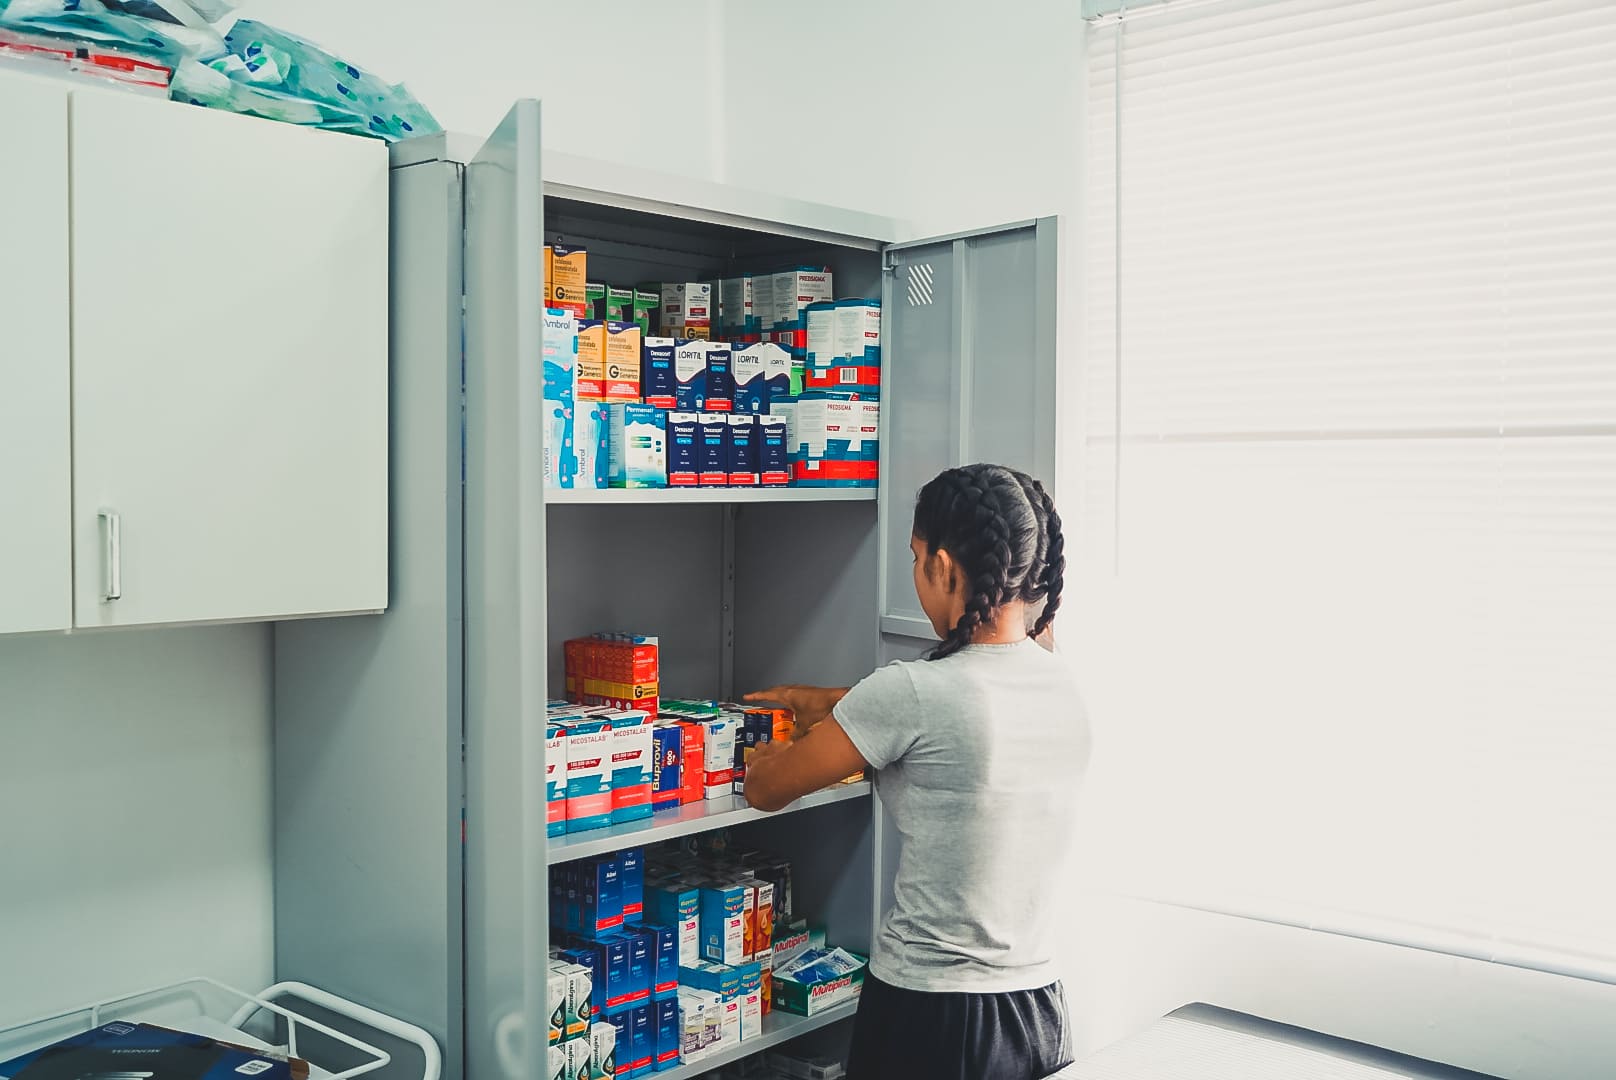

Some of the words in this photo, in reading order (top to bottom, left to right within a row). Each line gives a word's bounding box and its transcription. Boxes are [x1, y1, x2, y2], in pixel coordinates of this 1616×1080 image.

[555, 286, 565, 300] G
[678, 350, 703, 360] LORITIL
[609, 365, 619, 379] G
[827, 403, 852, 411] PREDSIGMA
[570, 735, 607, 745] MICOSTALAB
[613, 728, 647, 738] MICOSTALAB
[653, 738, 661, 791] Buprovil
[774, 931, 809, 953] Multipiral
[811, 975, 852, 997] Multipiral
